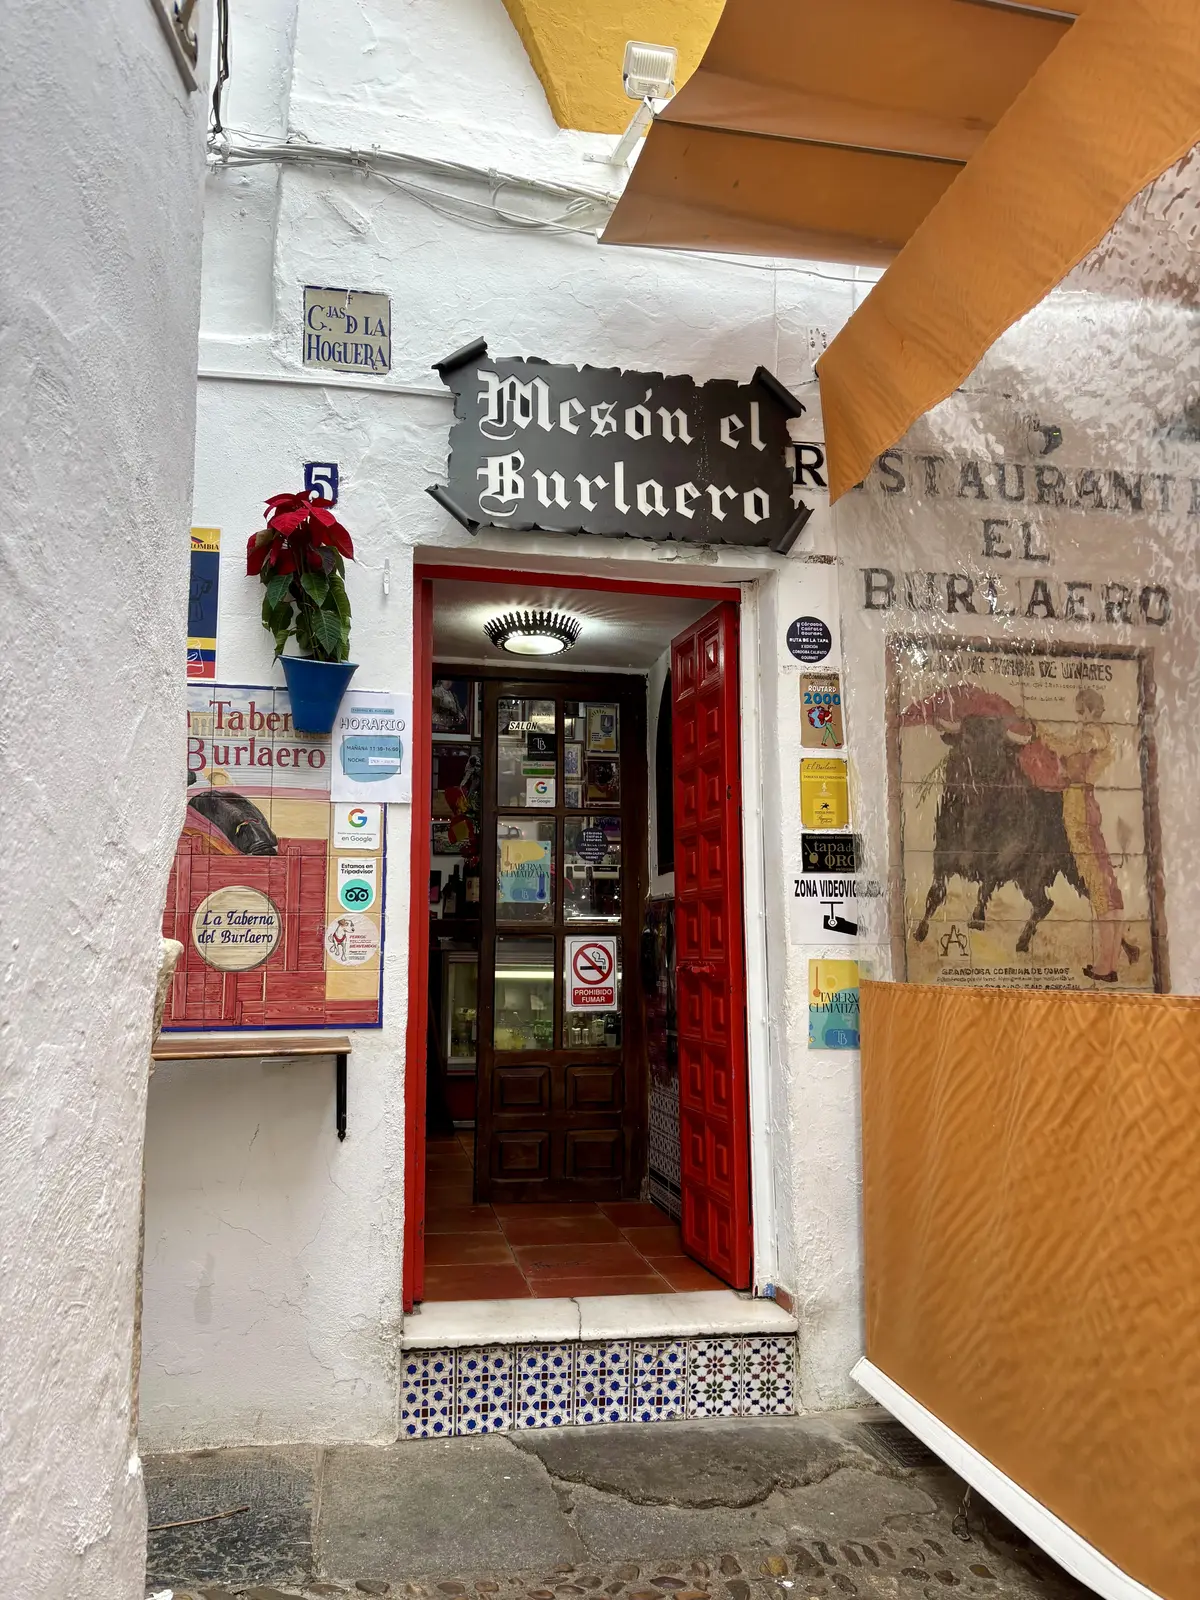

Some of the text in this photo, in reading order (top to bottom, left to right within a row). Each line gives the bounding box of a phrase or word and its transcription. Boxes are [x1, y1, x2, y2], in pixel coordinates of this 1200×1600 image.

[364, 315, 388, 337] LA
[307, 333, 388, 371] HOGUERA
[476, 368, 767, 452] Mesón el
[309, 466, 333, 502] 5
[476, 448, 770, 525] Burlaero
[980, 518, 1051, 562] EL
[803, 692, 841, 705] 2000
[209, 700, 292, 731] Taber
[340, 717, 406, 731] HORARIO
[187, 736, 326, 771] Burlaero
[794, 880, 818, 897] ZONA
[202, 910, 274, 926] La Taberna
[198, 929, 273, 944] del Burlaero
[809, 1003, 860, 1013] CLIMATIZA
[820, 992, 860, 1004] TABERN
